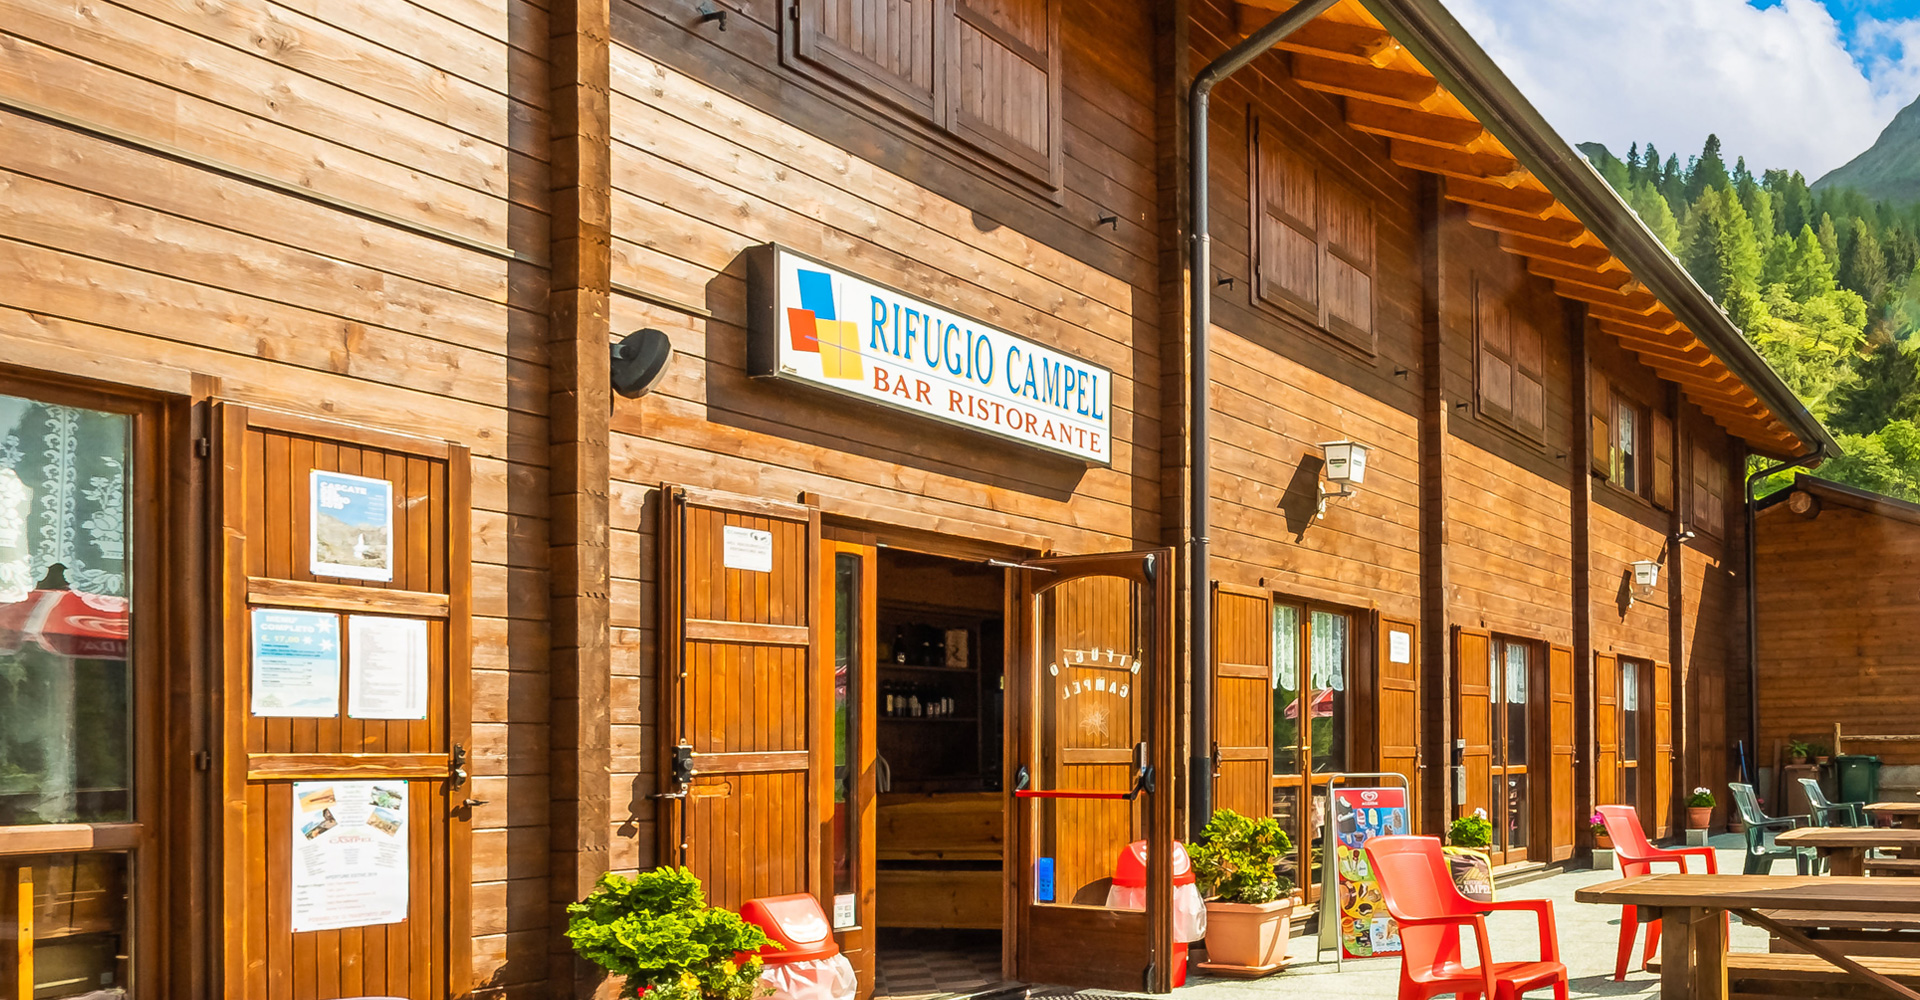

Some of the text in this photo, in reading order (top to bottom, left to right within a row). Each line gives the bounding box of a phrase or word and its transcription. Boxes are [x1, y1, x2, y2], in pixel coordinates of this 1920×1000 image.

[870, 295, 1104, 421] RIFUGIO CAMPEL
[873, 366, 1102, 453] BAR RISTORANTE
[260, 623, 315, 633] COMPLETO
[1456, 884, 1492, 894] CAMPEL
